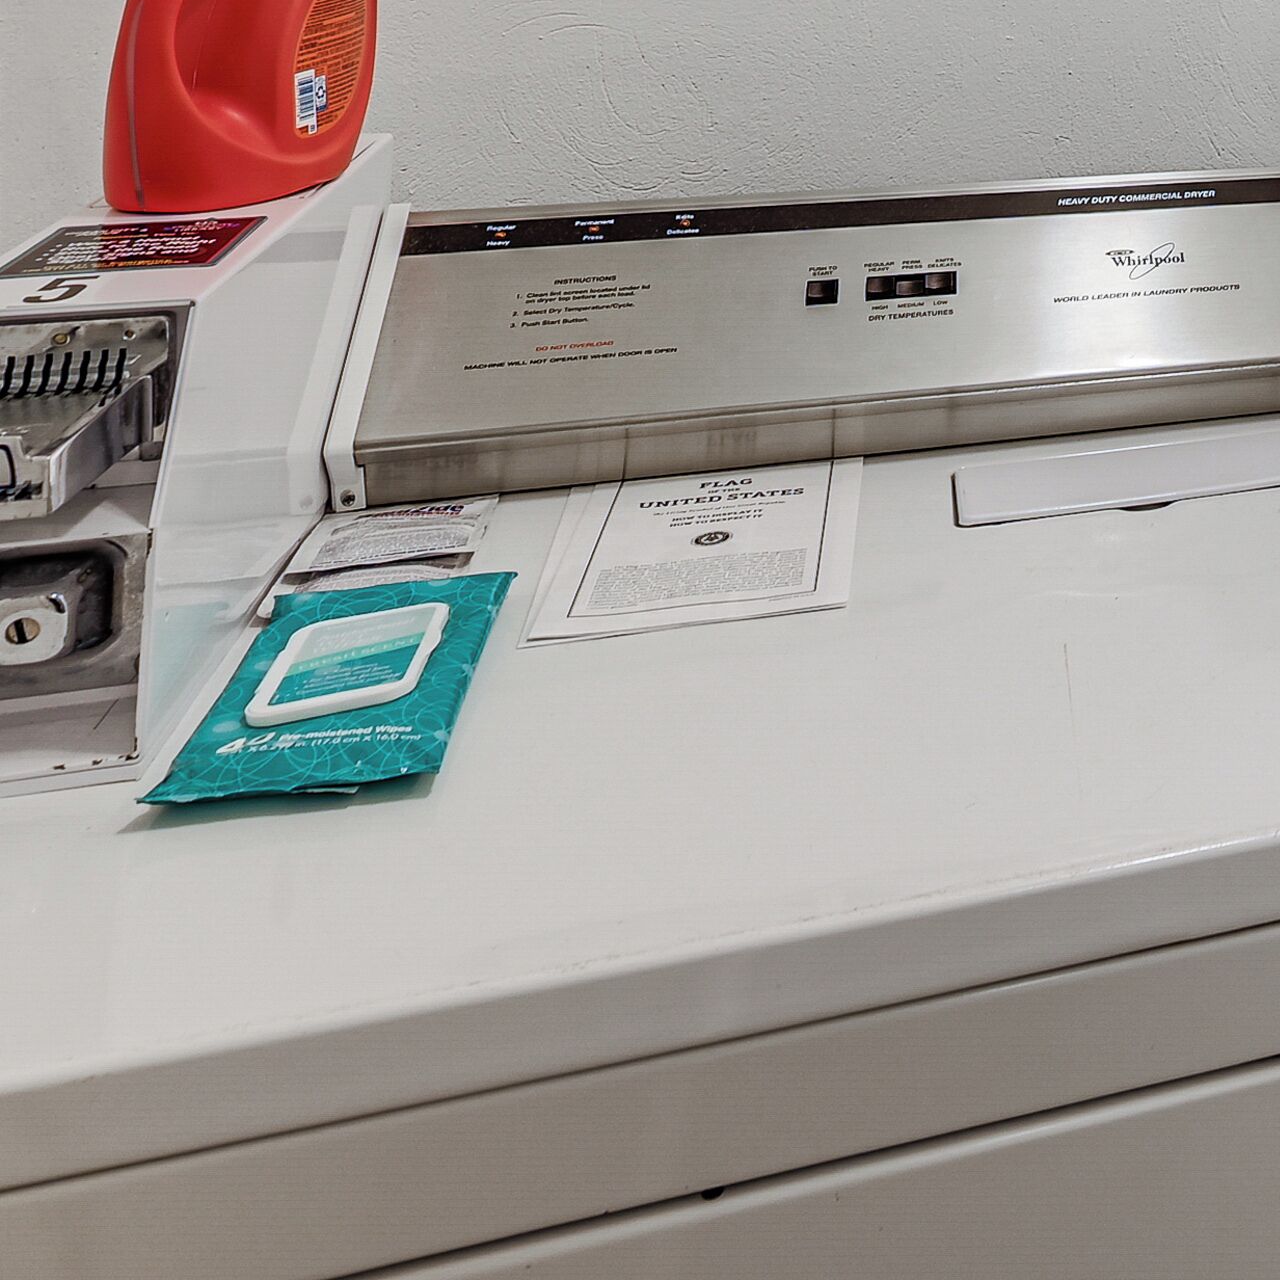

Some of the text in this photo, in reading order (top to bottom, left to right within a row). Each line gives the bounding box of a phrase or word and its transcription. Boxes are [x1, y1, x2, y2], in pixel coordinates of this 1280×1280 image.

[1058, 190, 1216, 206] HEAVY DUTY COMMERCIAL DRYER
[1112, 252, 1185, 267] Whirlpool
[554, 275, 616, 285] INSTRUCTIONS
[23, 276, 100, 303] 5
[563, 288, 588, 296] screen
[590, 286, 617, 295] located
[619, 285, 640, 293] under
[1091, 292, 1129, 301] LEADER
[1143, 288, 1188, 296] LAUNDRY
[1190, 284, 1240, 293] PRODUCTS
[537, 296, 557, 305] dryer
[559, 295, 571, 303] top
[598, 292, 616, 300] each
[524, 308, 547, 316] Select
[549, 307, 562, 316] Dry
[888, 309, 953, 320] TEMPERATURES
[521, 320, 541, 328] Push
[570, 340, 614, 349] OVERLOAD
[464, 361, 506, 371] MACHINE
[507, 360, 528, 368] WILL
[530, 358, 548, 366] NOT
[550, 354, 588, 364] OPERATE
[590, 352, 616, 361] WHEN
[618, 350, 642, 358] DOOR
[654, 347, 677, 355] OPEN
[699, 478, 752, 490] FLAG
[639, 496, 722, 509] UNITED
[726, 487, 805, 502] STATES
[216, 732, 276, 755] 40
[279, 727, 372, 741] Pre-moistened
[375, 725, 413, 734] Wipes
